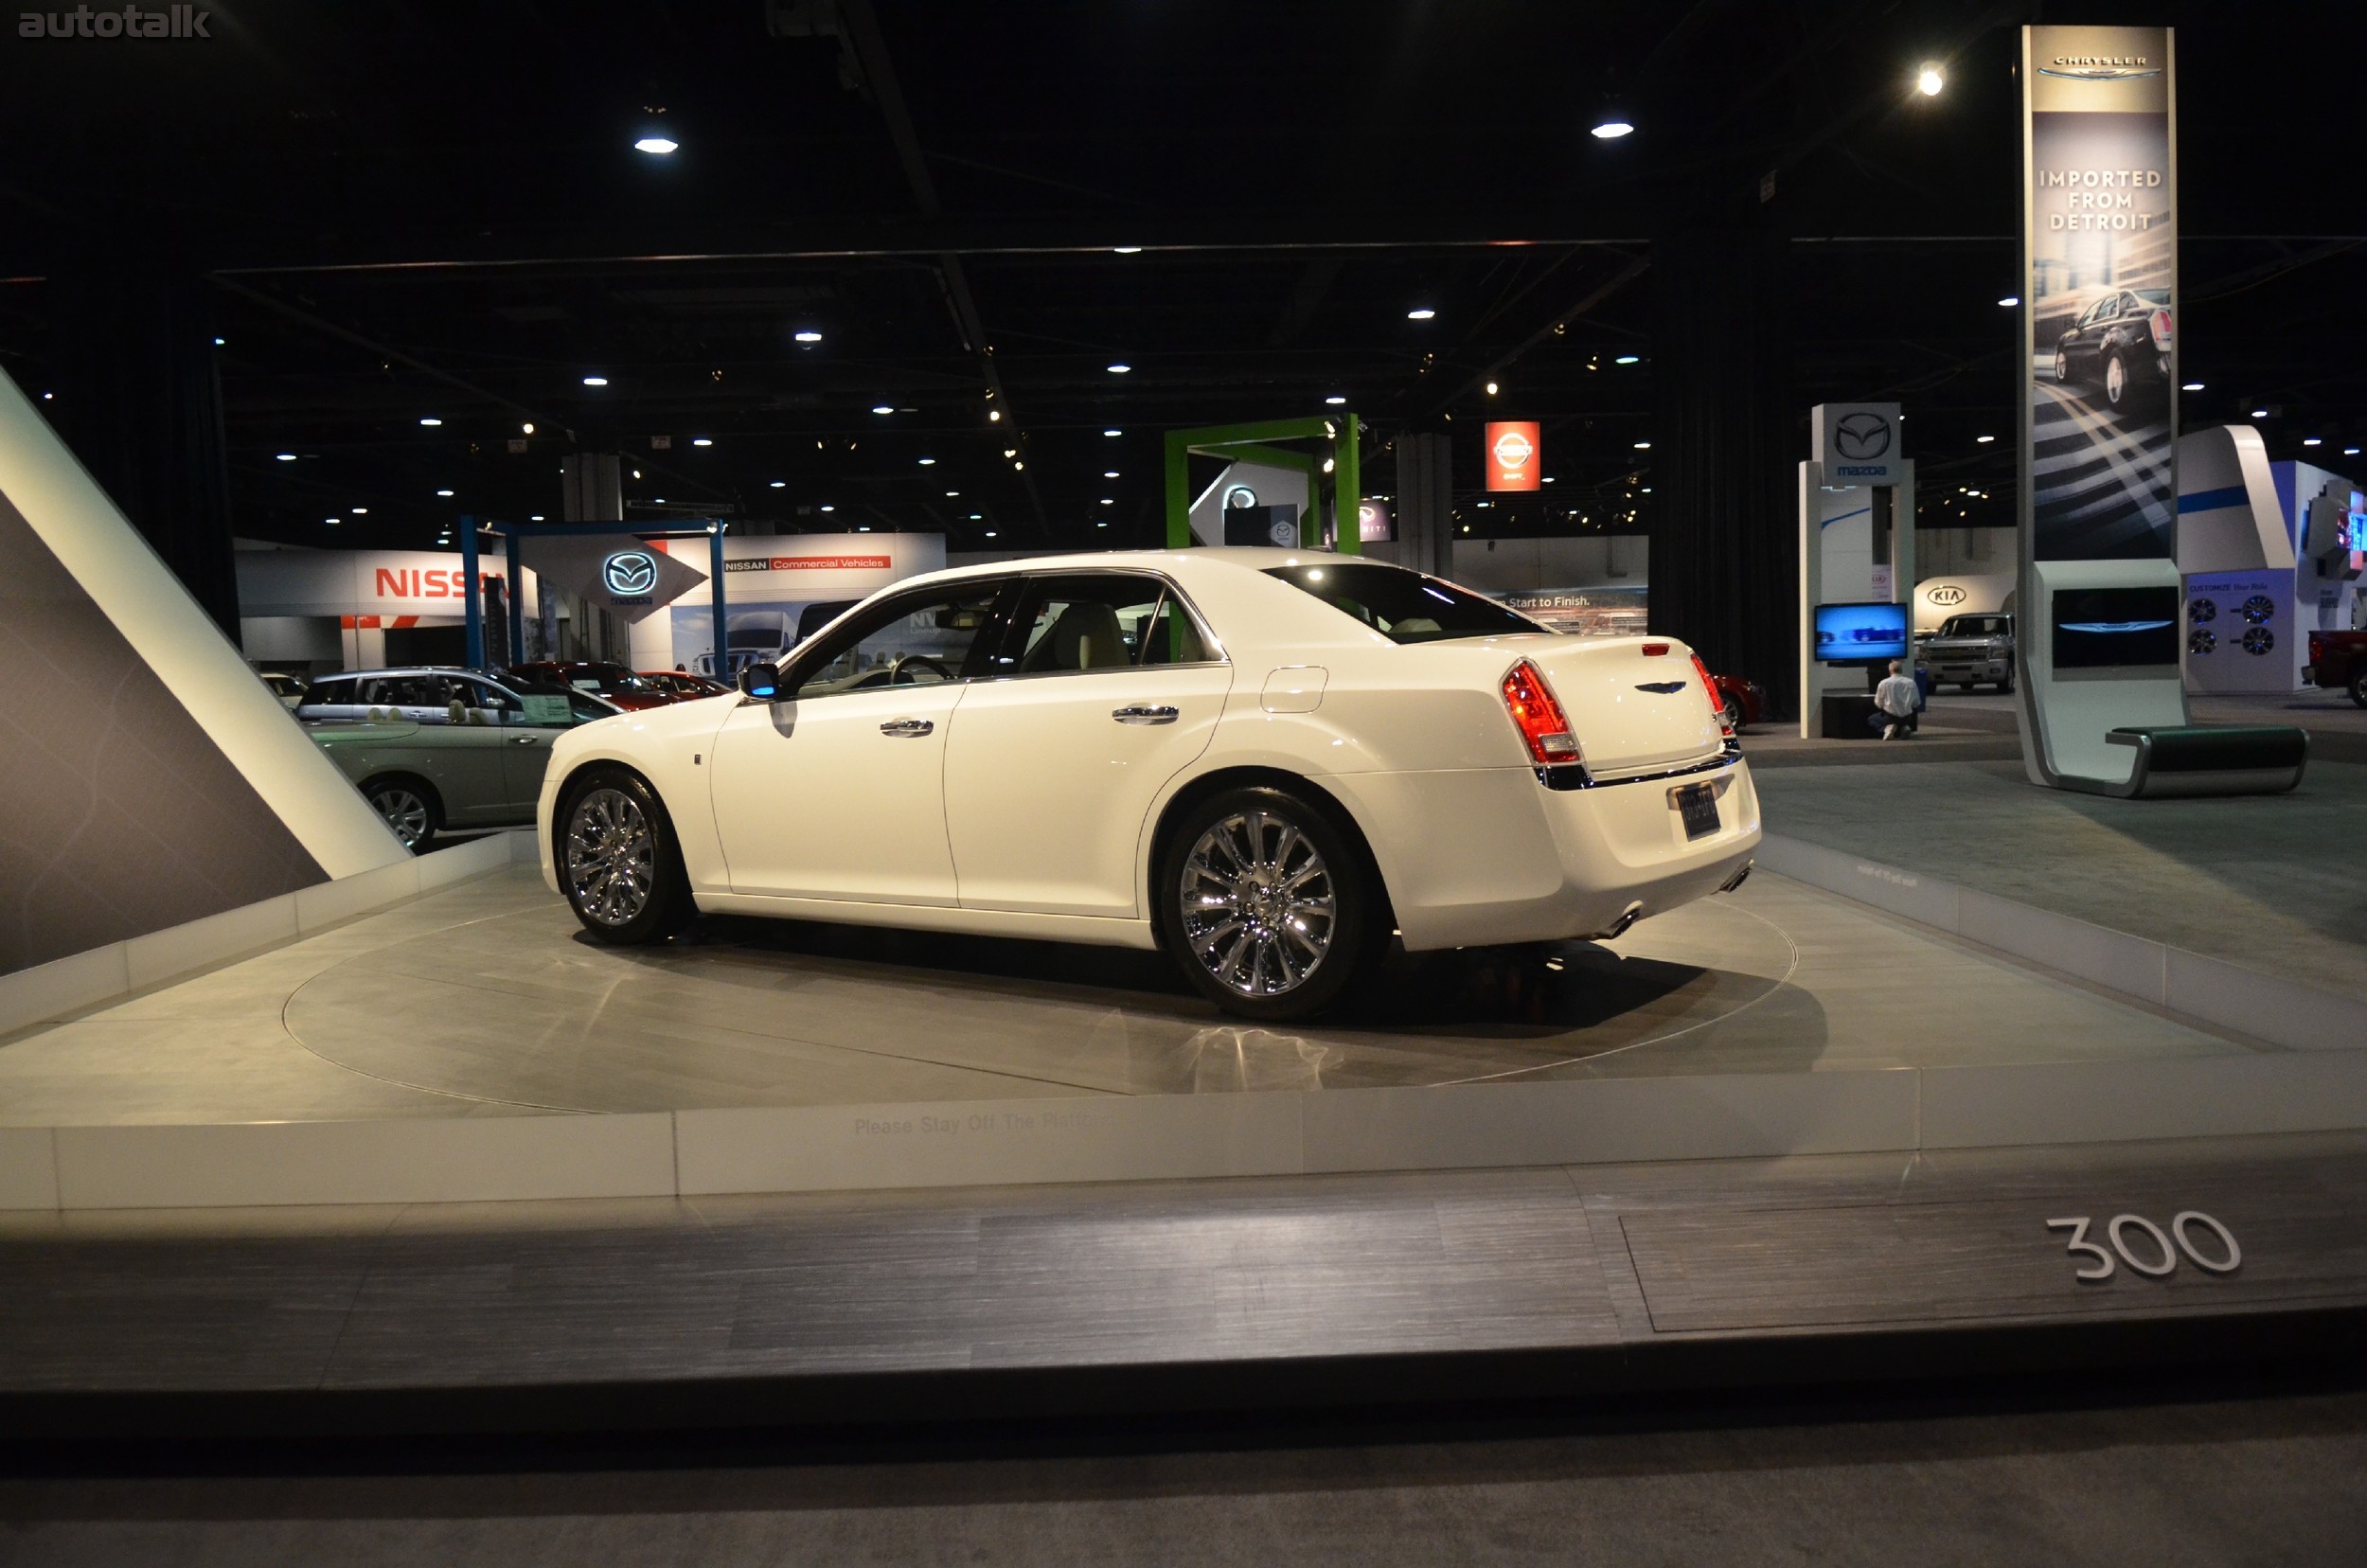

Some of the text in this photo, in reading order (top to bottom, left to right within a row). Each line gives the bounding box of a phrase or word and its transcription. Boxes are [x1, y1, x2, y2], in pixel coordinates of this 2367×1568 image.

[2055, 57, 2146, 65] CHRYSLER
[2039, 170, 2161, 187] IMPORTED
[2069, 192, 2132, 208] FROM
[2050, 214, 2151, 230] DETROIT
[725, 558, 883, 571] NISSAN Commercial Vehicles
[376, 569, 509, 598] NISS
[1509, 597, 1536, 609] Start
[1539, 598, 1552, 607] to
[1555, 596, 1590, 607] Finish.
[1934, 590, 1960, 600] KIA
[855, 1118, 912, 1135] Please
[920, 1115, 960, 1134] Stay
[968, 1114, 995, 1131] Off
[1004, 1113, 1035, 1129] The
[2046, 1210, 2242, 1279] 300
